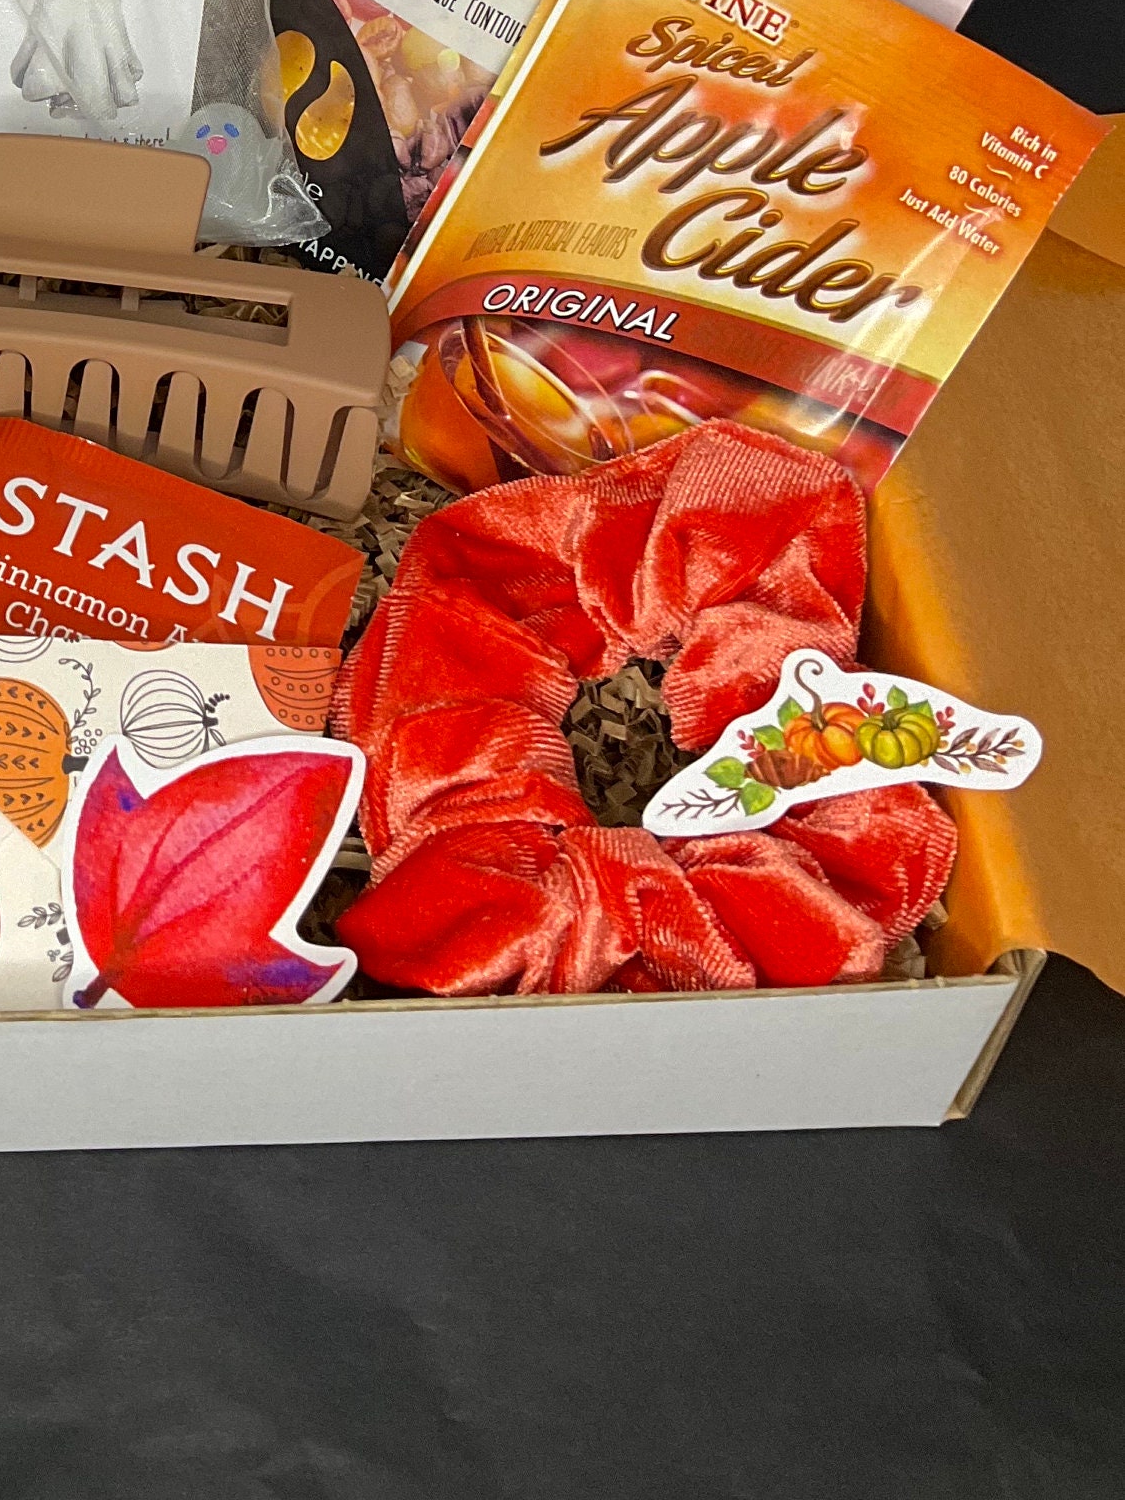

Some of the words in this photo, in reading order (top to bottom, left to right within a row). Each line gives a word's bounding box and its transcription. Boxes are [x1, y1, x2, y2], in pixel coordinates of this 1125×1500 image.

[625, 16, 818, 88] Spiced
[539, 74, 869, 196] Apple
[981, 132, 1033, 172] Vitamin
[1034, 164, 1049, 179] C
[1009, 125, 1040, 153] Rich
[1041, 144, 1057, 162] in
[899, 188, 929, 212] Just
[926, 204, 959, 230] Add
[958, 220, 1000, 255] Water
[948, 165, 968, 184] 80
[969, 177, 1022, 217] Calories
[641, 187, 924, 324] Cider
[481, 282, 681, 343] ORIGINAL
[5, 601, 91, 640] Cha
